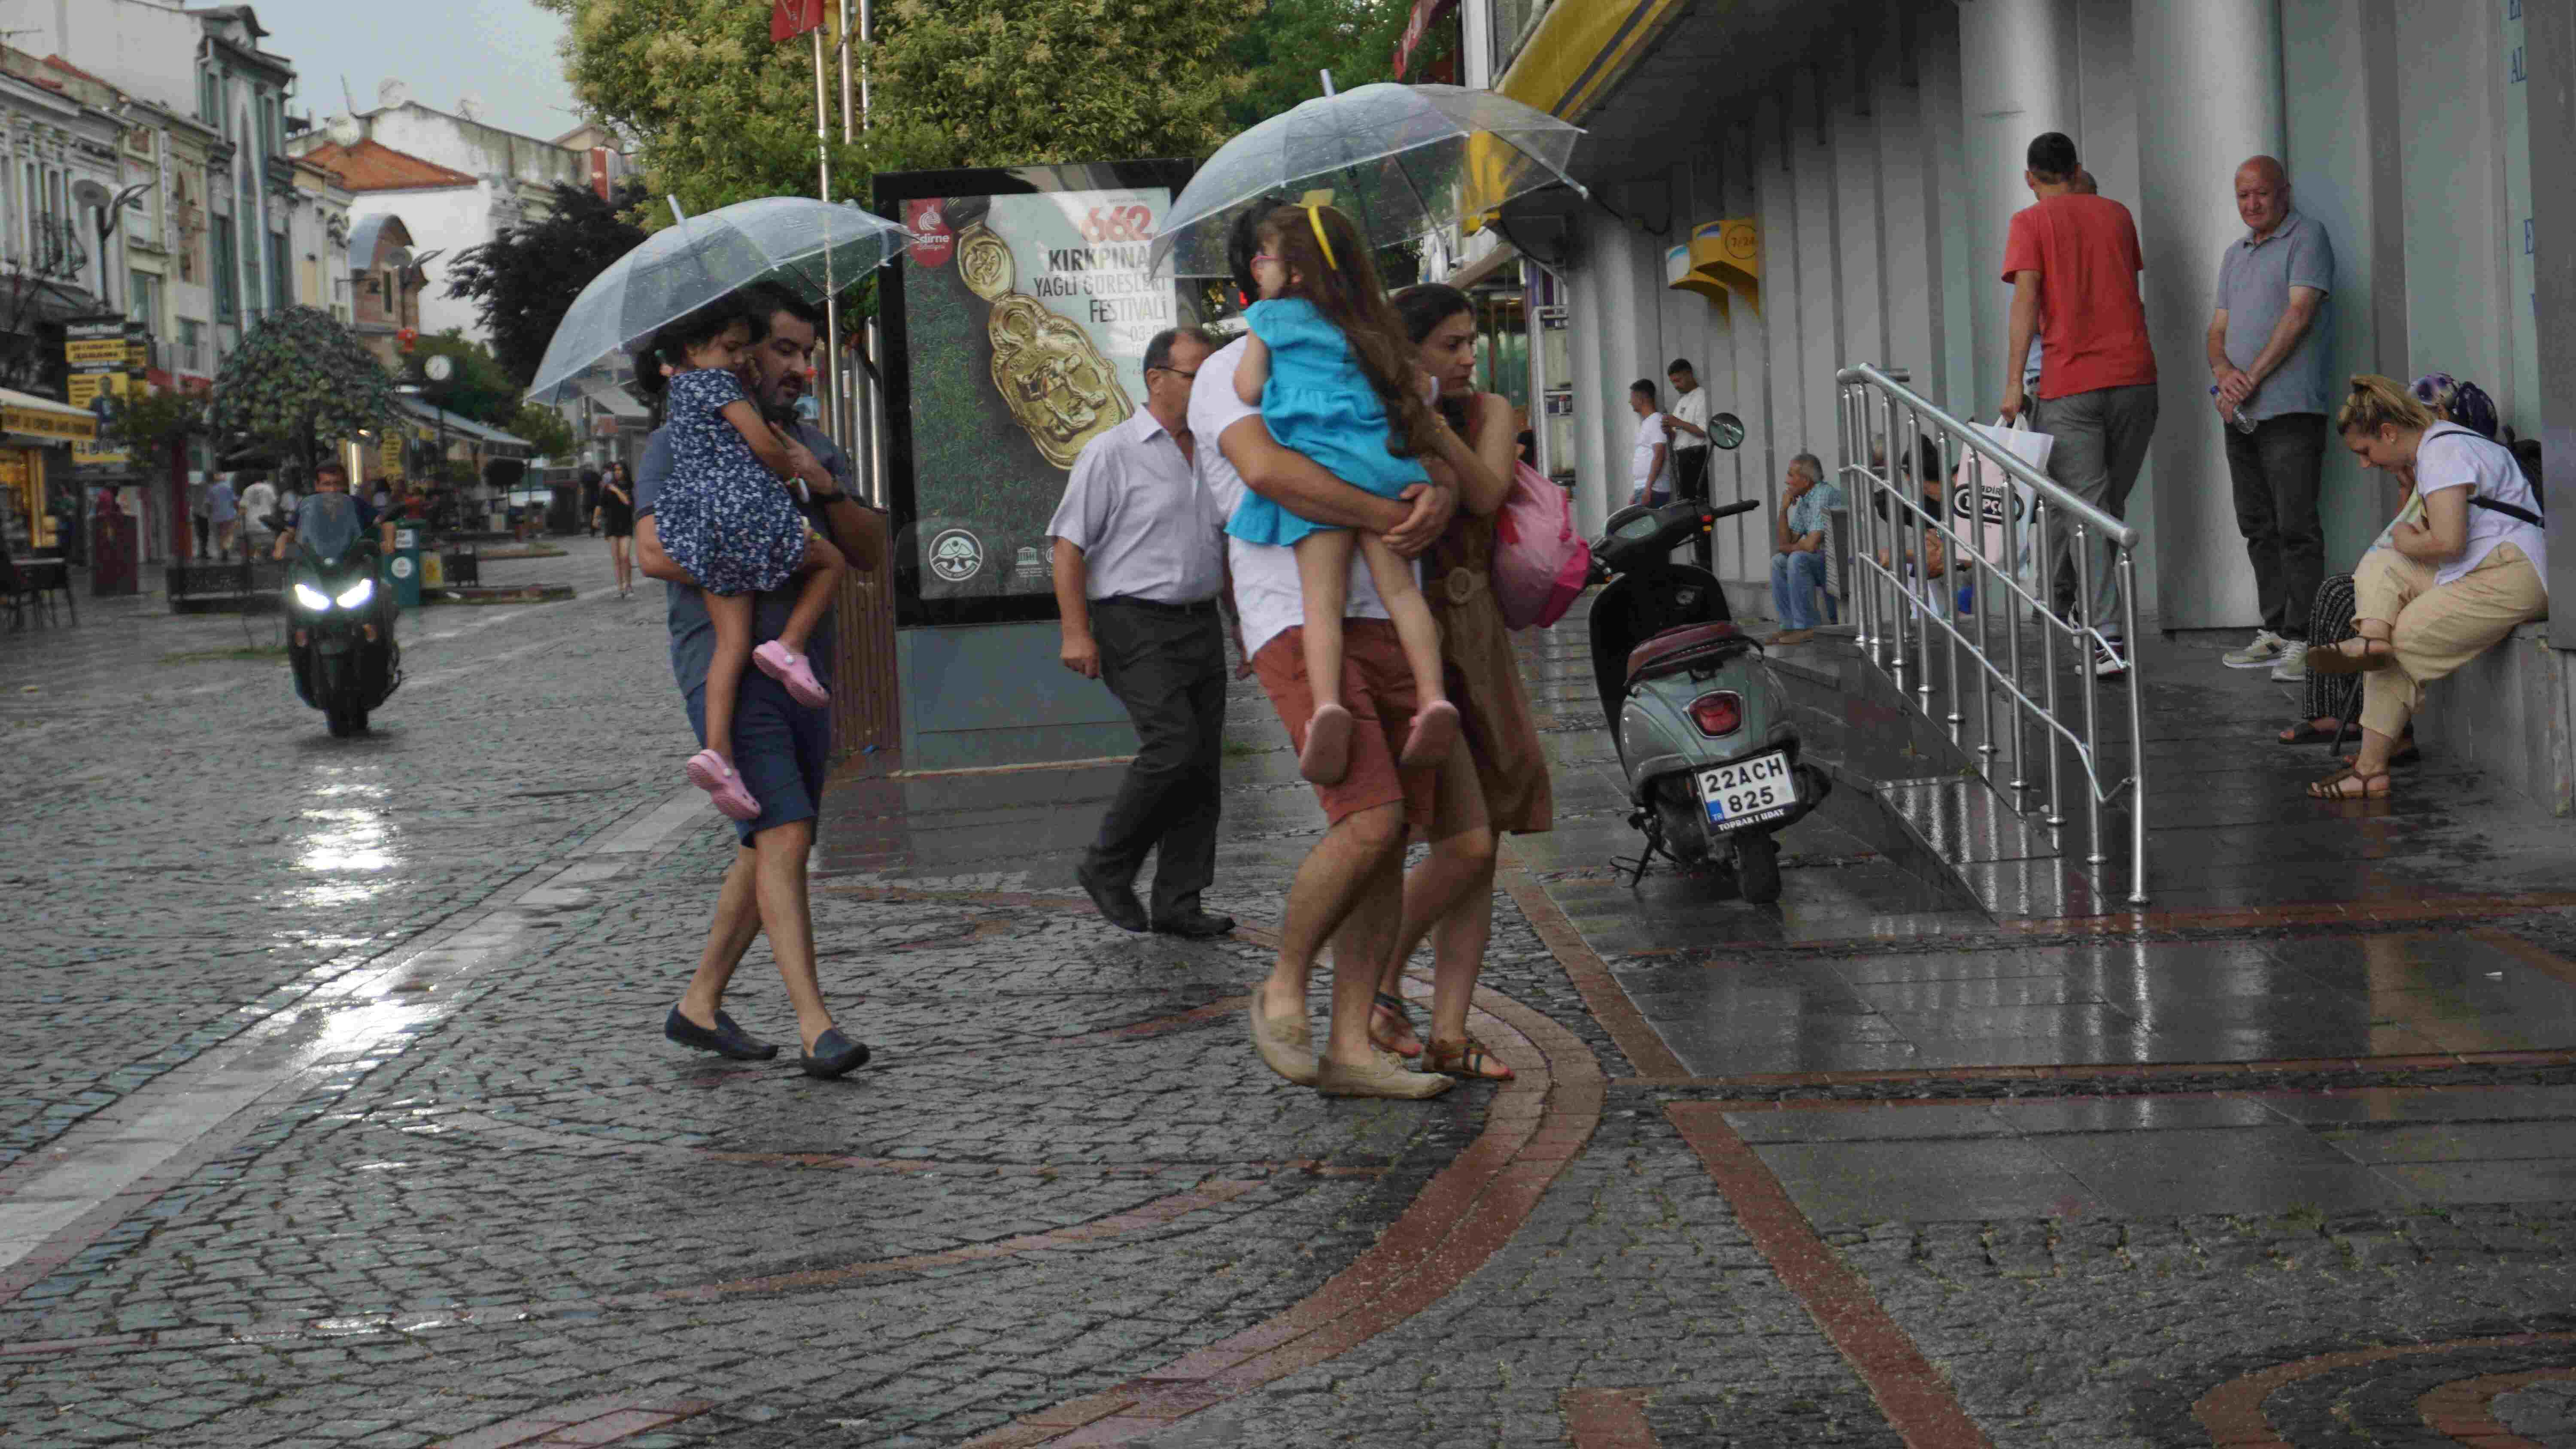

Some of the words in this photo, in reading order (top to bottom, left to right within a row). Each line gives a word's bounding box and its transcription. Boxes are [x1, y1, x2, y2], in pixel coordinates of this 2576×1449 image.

[1081, 205, 1153, 243] 662
[1048, 246, 1151, 272] KIRKPINA
[1705, 757, 1783, 793] 22ACH
[1728, 785, 1774, 813] 825
[1712, 812, 1722, 822] TR
